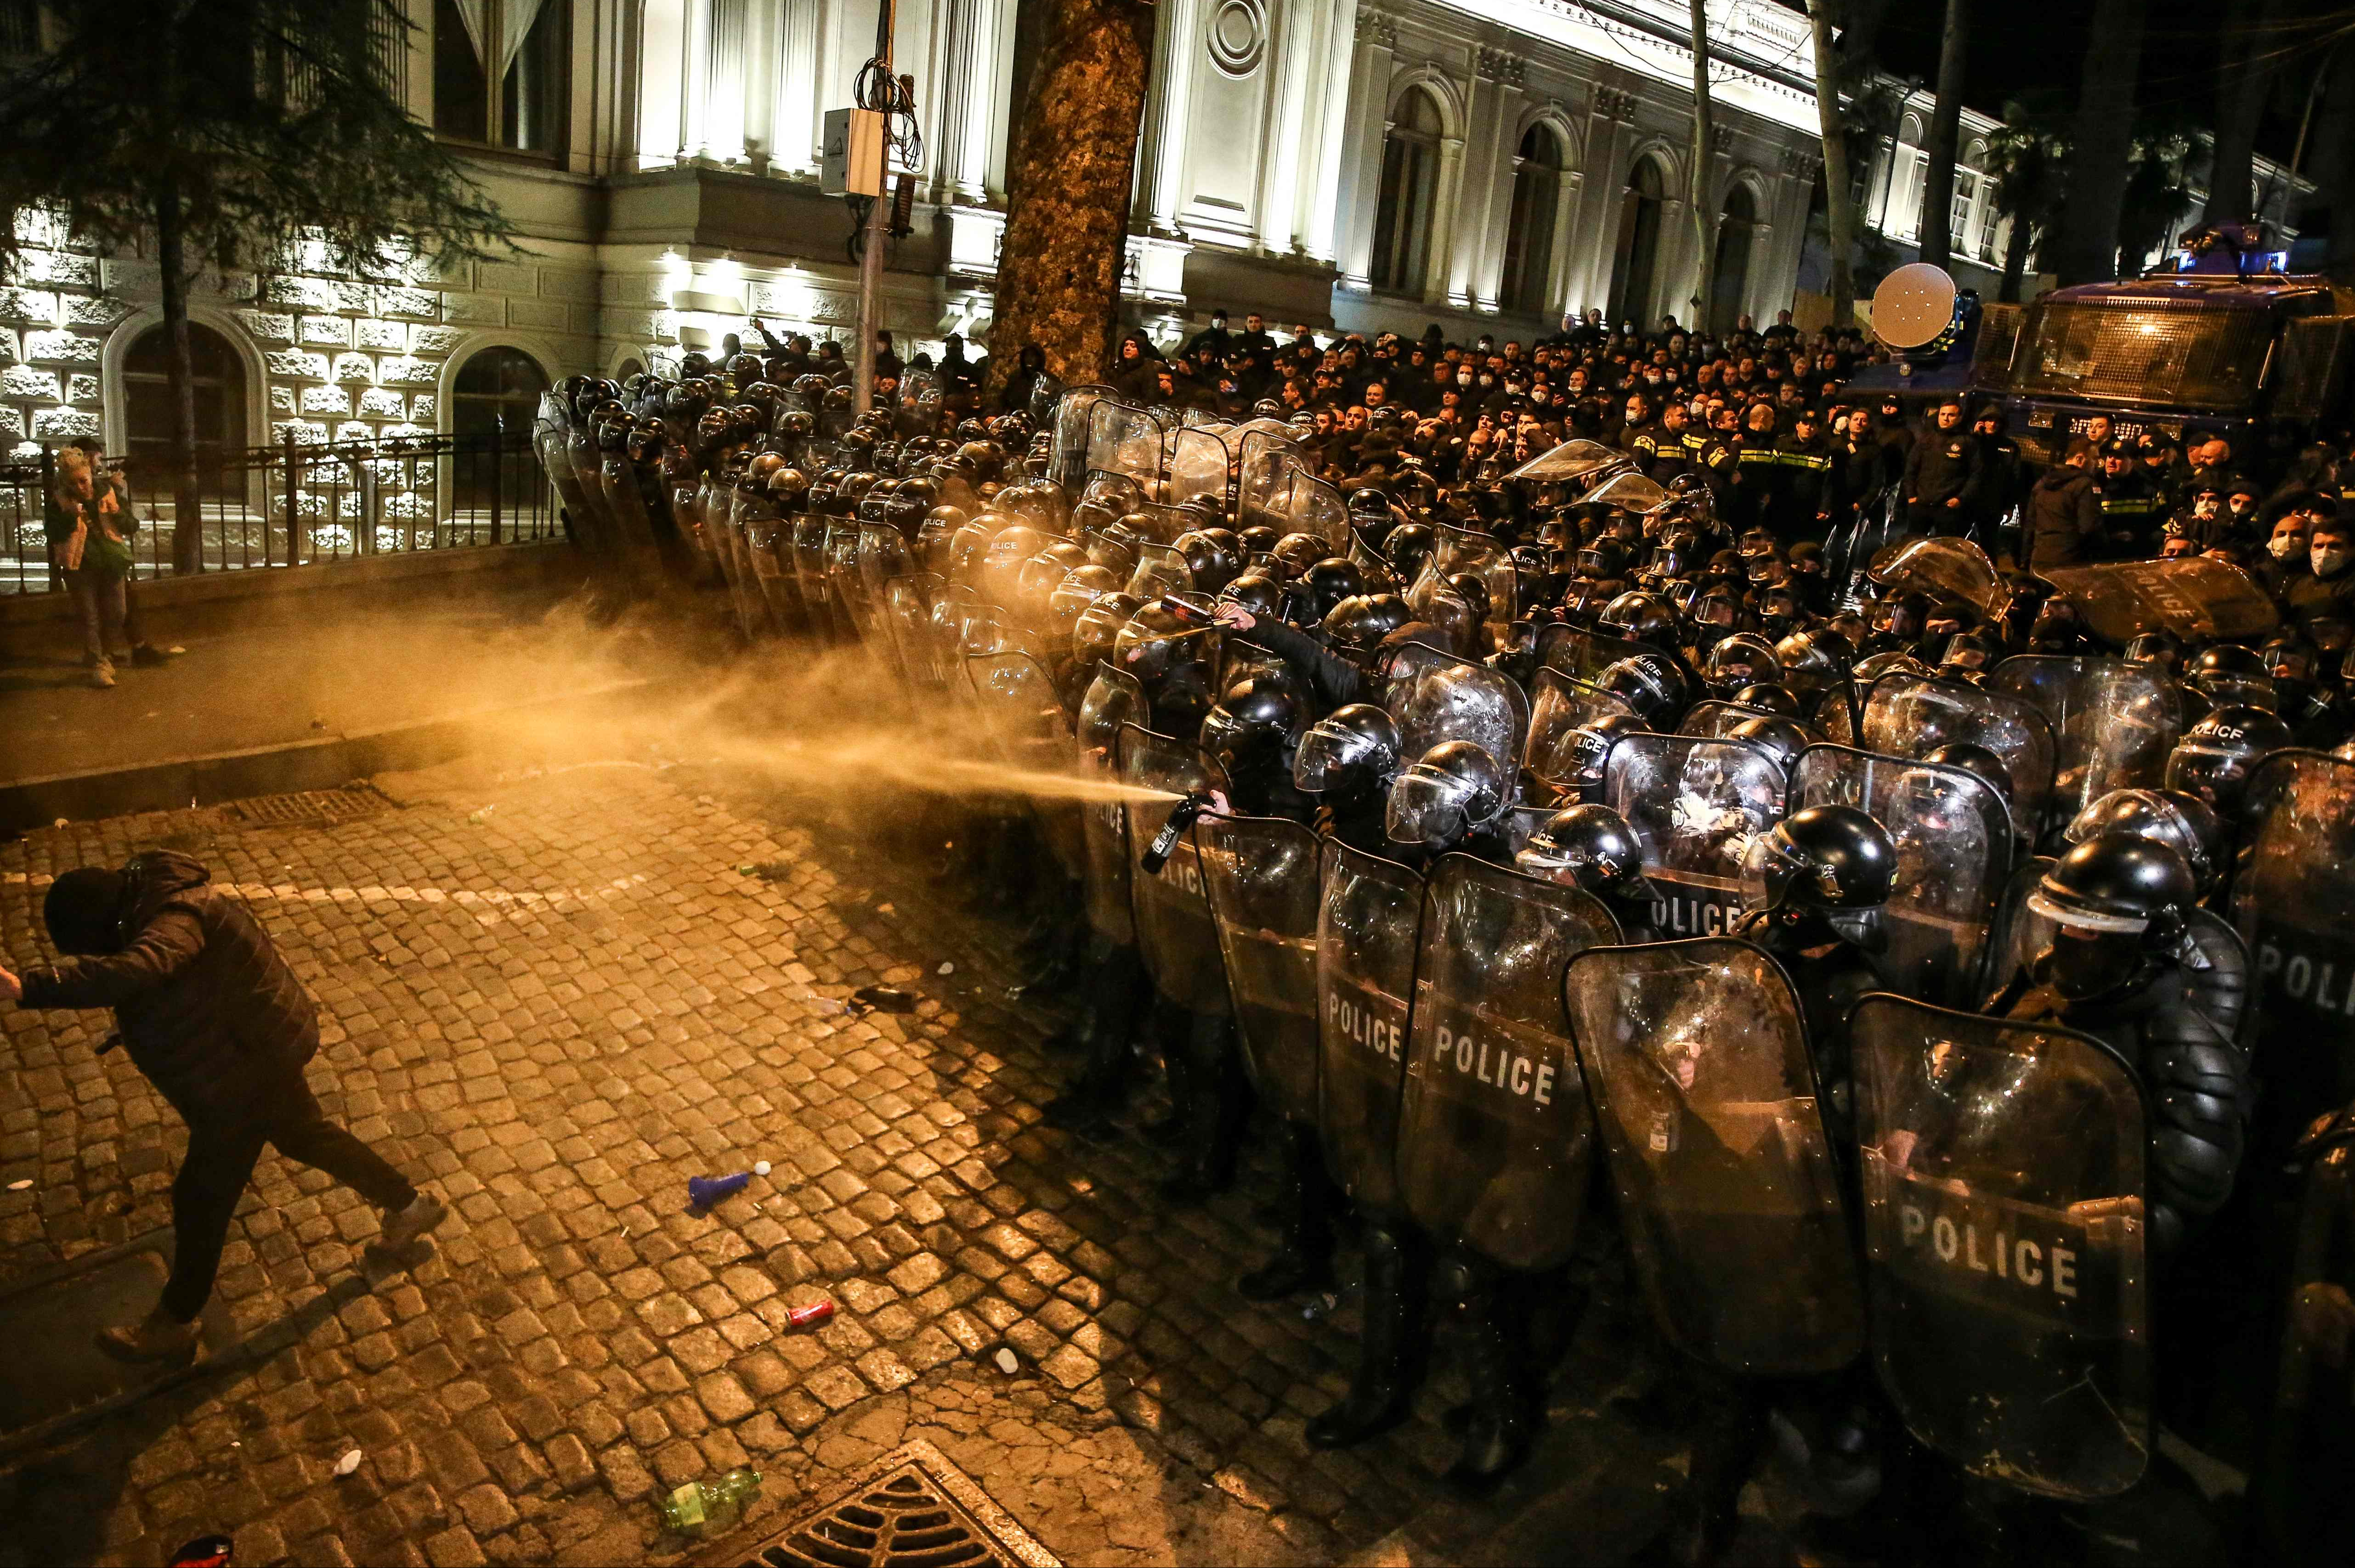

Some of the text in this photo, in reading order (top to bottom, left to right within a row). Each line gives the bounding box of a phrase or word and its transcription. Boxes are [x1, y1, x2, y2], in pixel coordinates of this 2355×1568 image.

[991, 541, 1017, 550] OLICE
[1064, 574, 1082, 584] LICE
[1098, 598, 1120, 610] LICE
[1634, 654, 1662, 677] OLICE
[1574, 737, 1603, 754] OLICE
[1651, 897, 1741, 936] OLICE
[2259, 943, 2355, 1015] POLI
[1329, 993, 1402, 1062] POLICE
[1435, 1026, 1555, 1105] POLICE
[1901, 1205, 2081, 1299] POLICE
